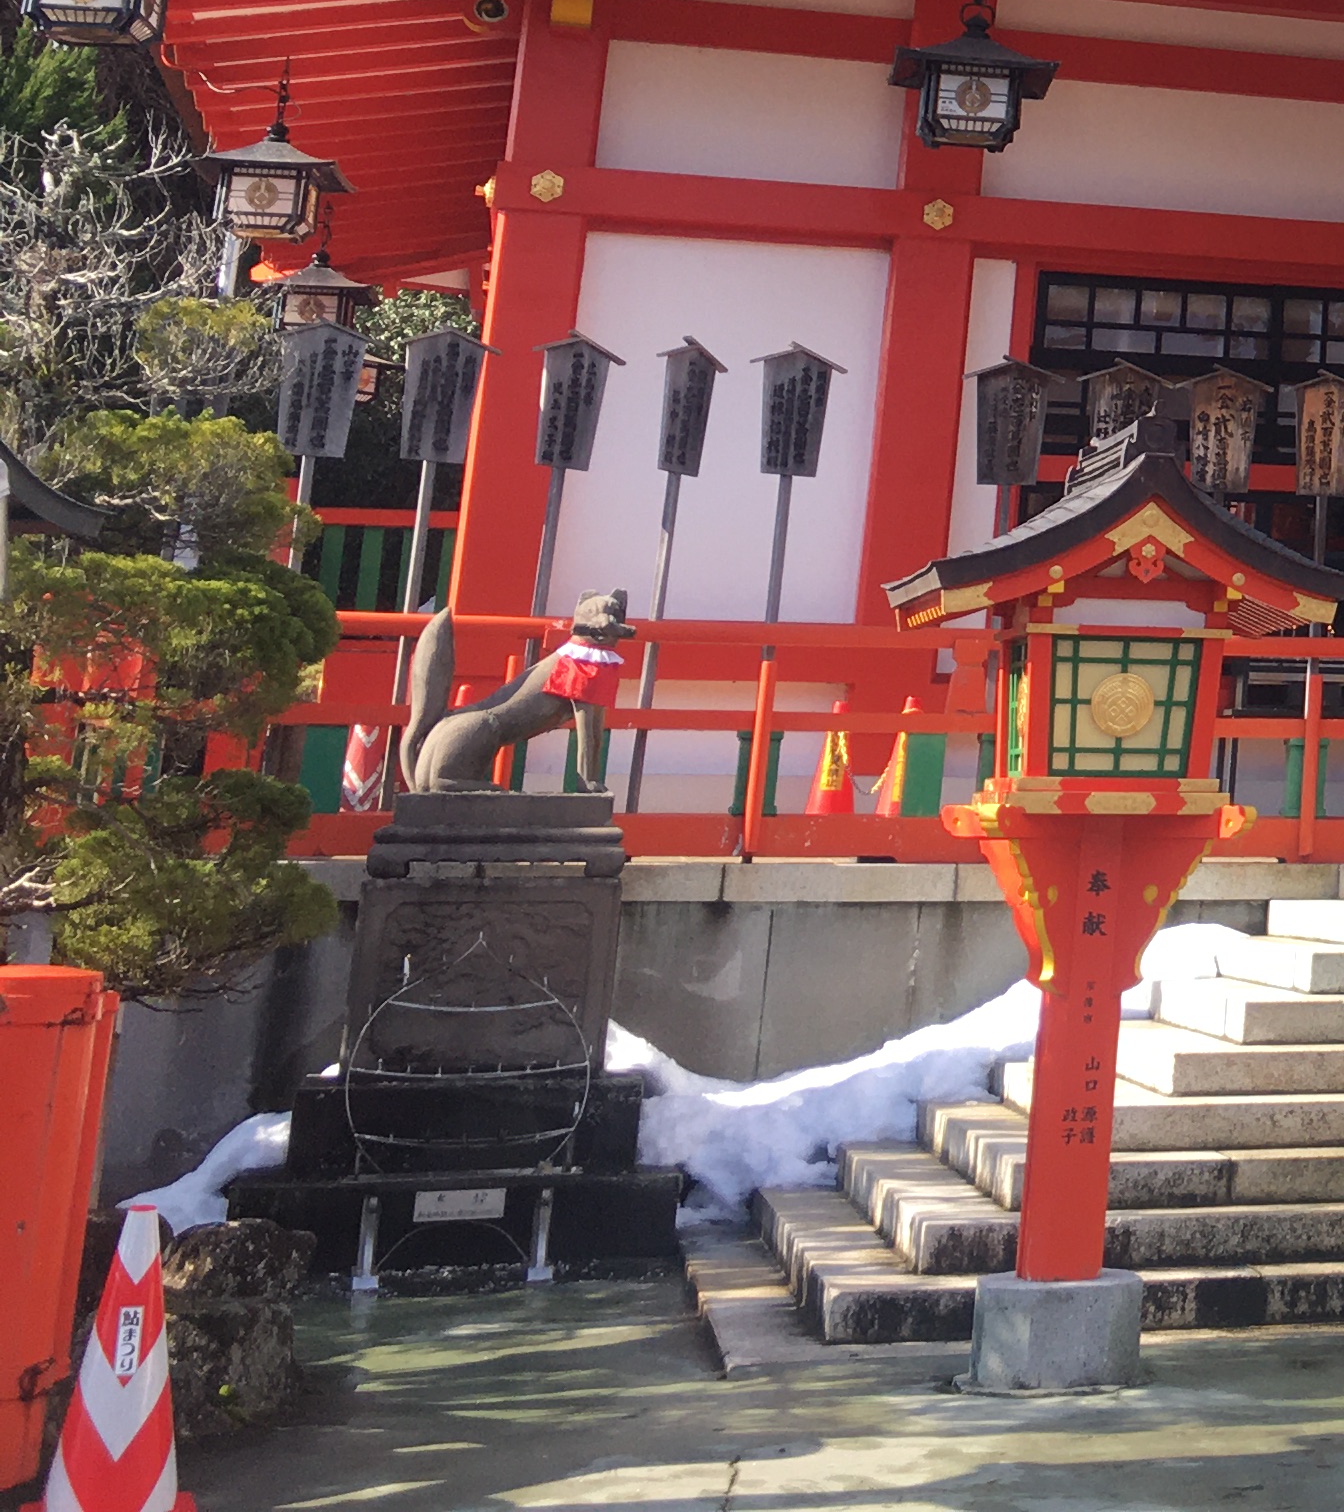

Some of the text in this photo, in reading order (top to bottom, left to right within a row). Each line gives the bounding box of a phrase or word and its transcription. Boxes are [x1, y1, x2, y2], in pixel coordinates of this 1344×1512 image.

[1083, 870, 1111, 936] 奉献
[1085, 1056, 1100, 1092] 山口
[121, 1310, 140, 1372] 鮎まつり
